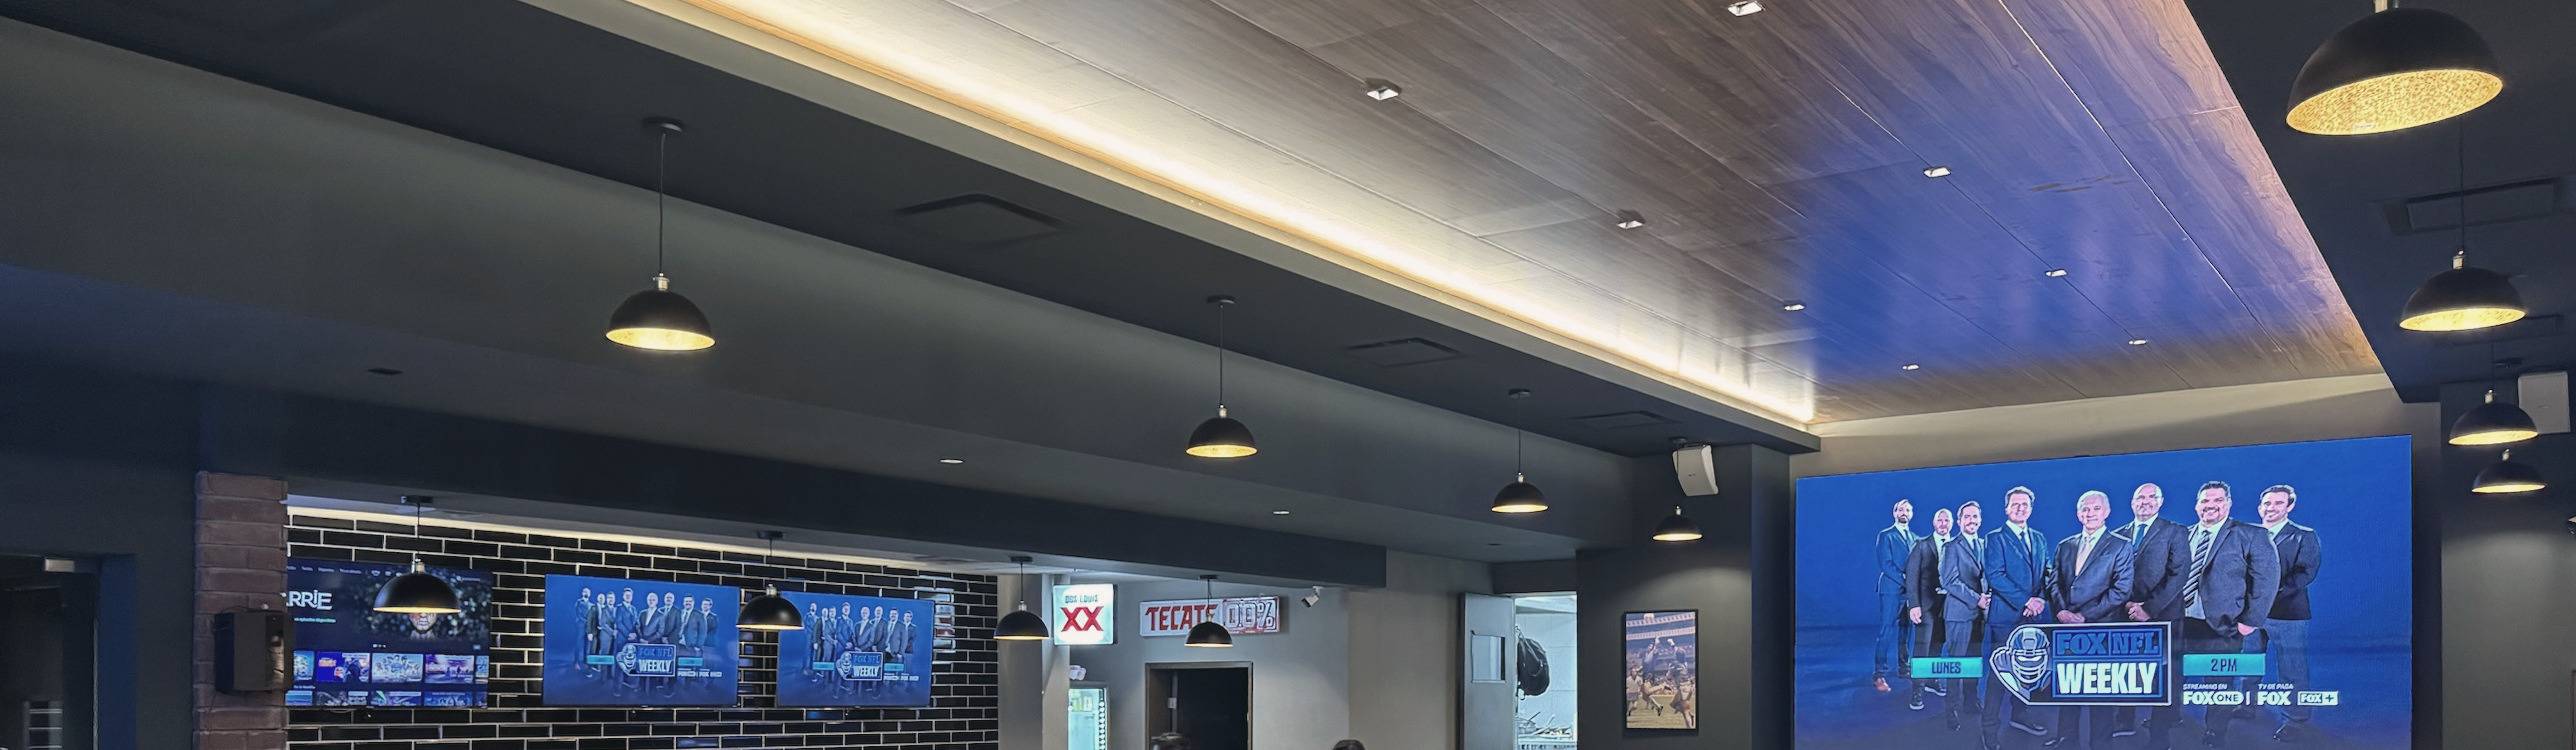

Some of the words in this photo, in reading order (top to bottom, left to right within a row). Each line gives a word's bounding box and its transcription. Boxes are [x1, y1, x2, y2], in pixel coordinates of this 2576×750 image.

[284, 590, 332, 610] RRIE
[1060, 606, 1104, 632] XX
[2056, 632, 2107, 656] FOX
[2111, 631, 2159, 655] NFL
[638, 659, 671, 672] WEEKLY
[1932, 661, 1961, 674] LUNES
[2211, 659, 2218, 672] 2
[2220, 659, 2237, 672] PM
[2056, 662, 2157, 694] WEEKLY
[2257, 691, 2291, 705] FOX
